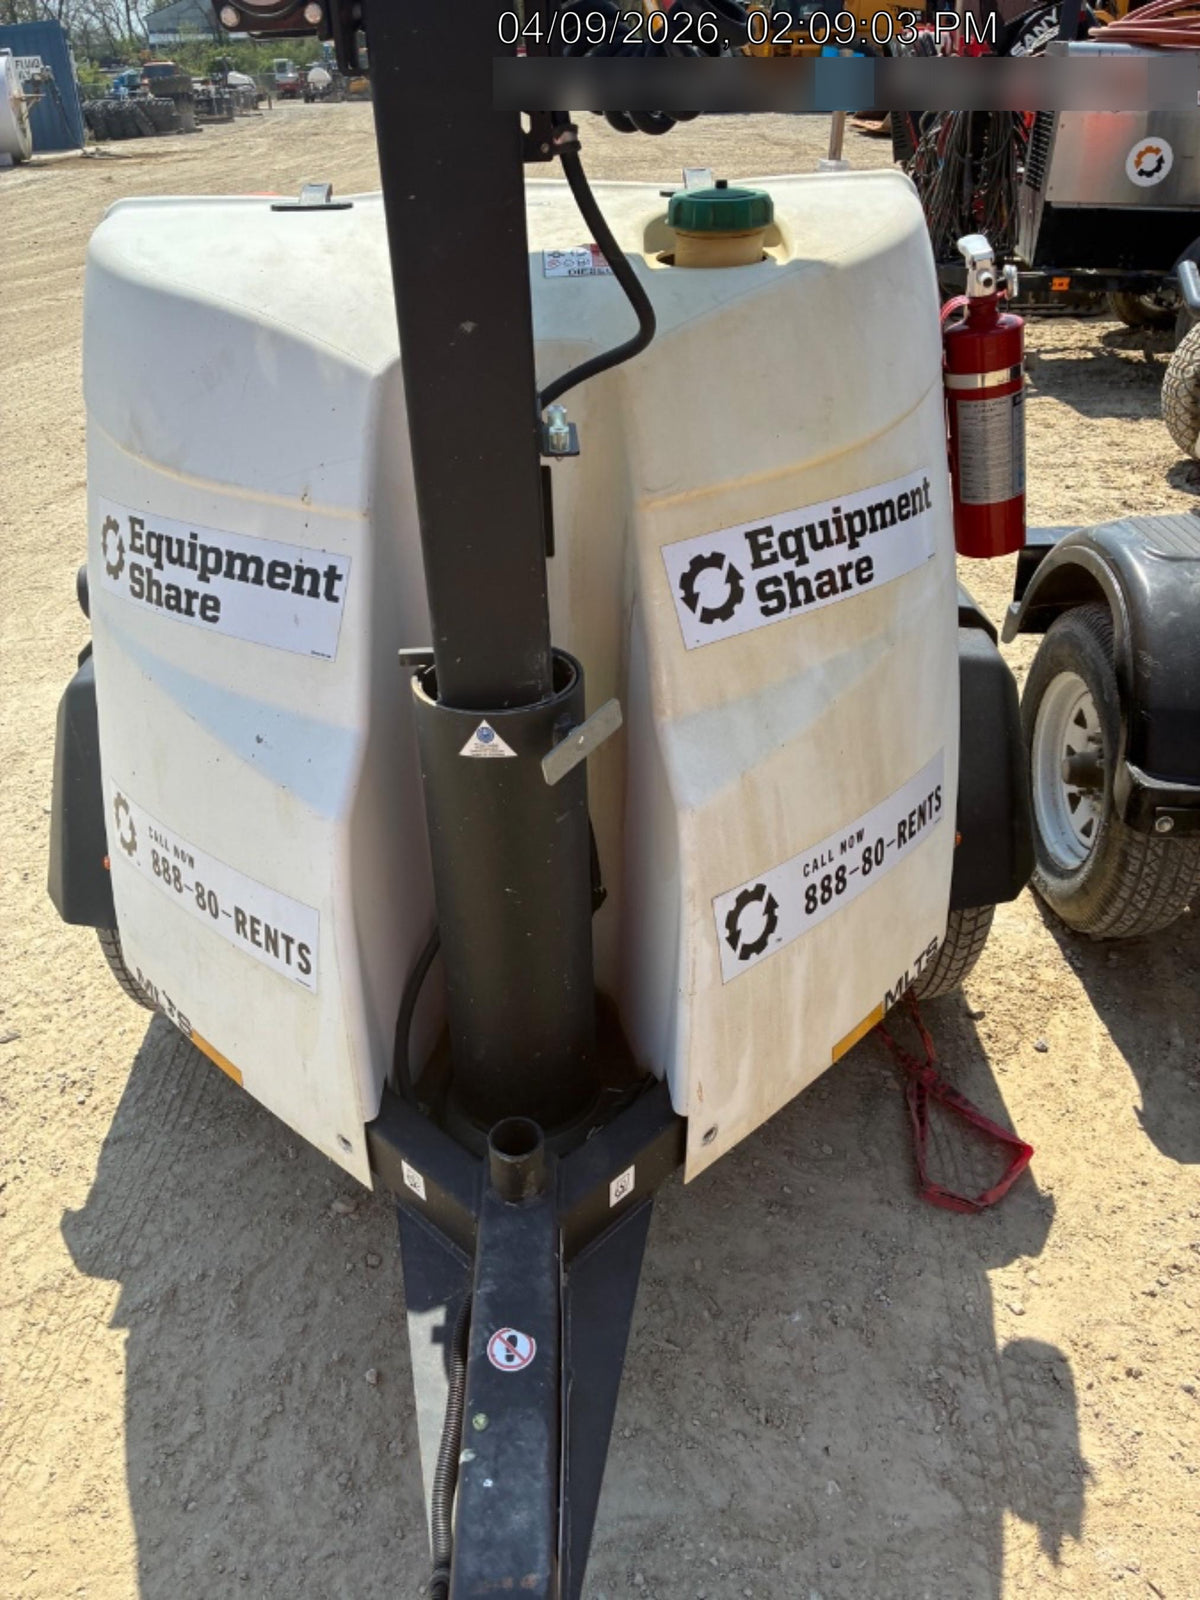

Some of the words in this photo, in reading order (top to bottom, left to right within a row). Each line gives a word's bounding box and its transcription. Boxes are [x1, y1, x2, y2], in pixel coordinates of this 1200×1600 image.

[1010, 7, 1058, 56] SANY
[128, 515, 343, 603] Equipment
[744, 477, 933, 571] Equipment
[129, 562, 221, 624] Share
[755, 555, 875, 618] Share
[148, 826, 170, 851] CALL
[173, 844, 195, 869] NOW
[803, 849, 835, 878] CALL
[840, 827, 866, 855] NOW
[804, 784, 943, 916] 888-80-RENTS
[151, 849, 312, 976] 888-80-RENTS
[884, 935, 938, 1012] MLTS
